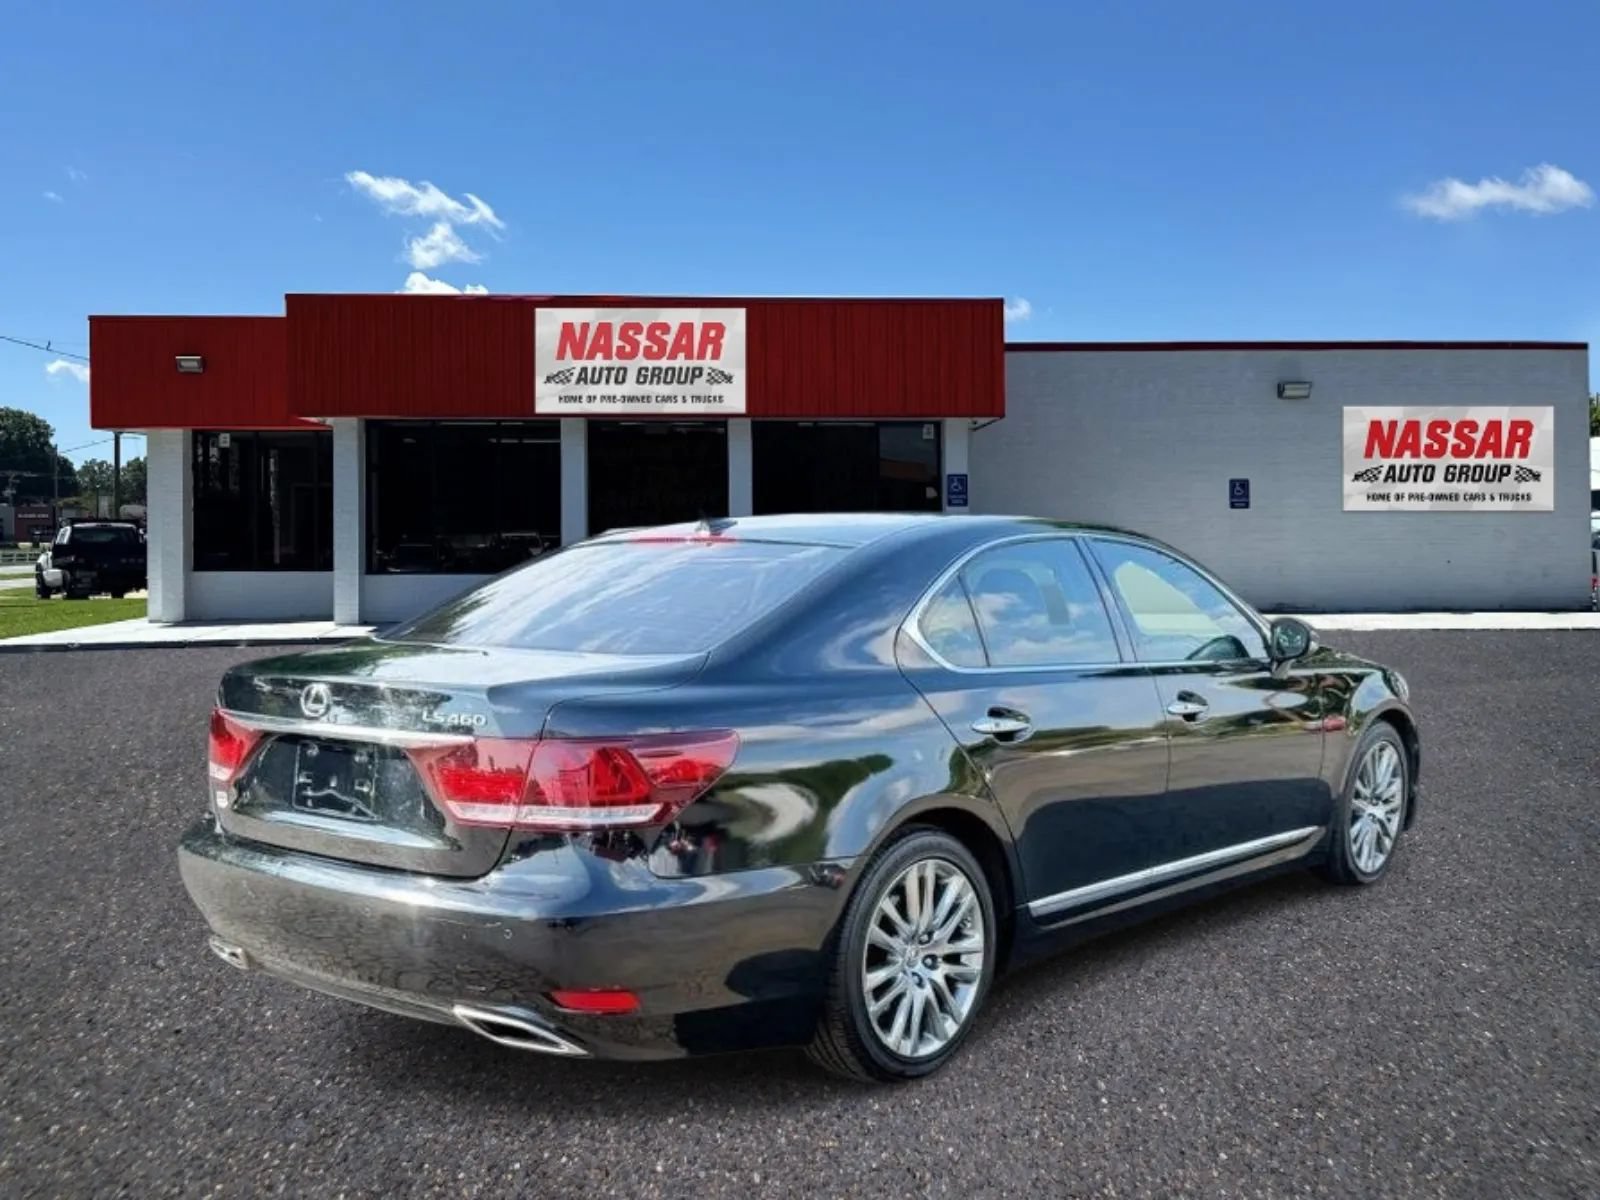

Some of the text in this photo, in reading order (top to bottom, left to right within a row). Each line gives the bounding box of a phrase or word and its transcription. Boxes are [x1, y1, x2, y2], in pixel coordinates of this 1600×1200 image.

[556, 322, 726, 361] NASSAR
[575, 366, 704, 385] AUTO GROUP
[1364, 420, 1534, 459] NASSAR
[1384, 464, 1512, 483] AUTO GROUP
[1366, 492, 1391, 502] HOME
[1463, 492, 1486, 502] CARS
